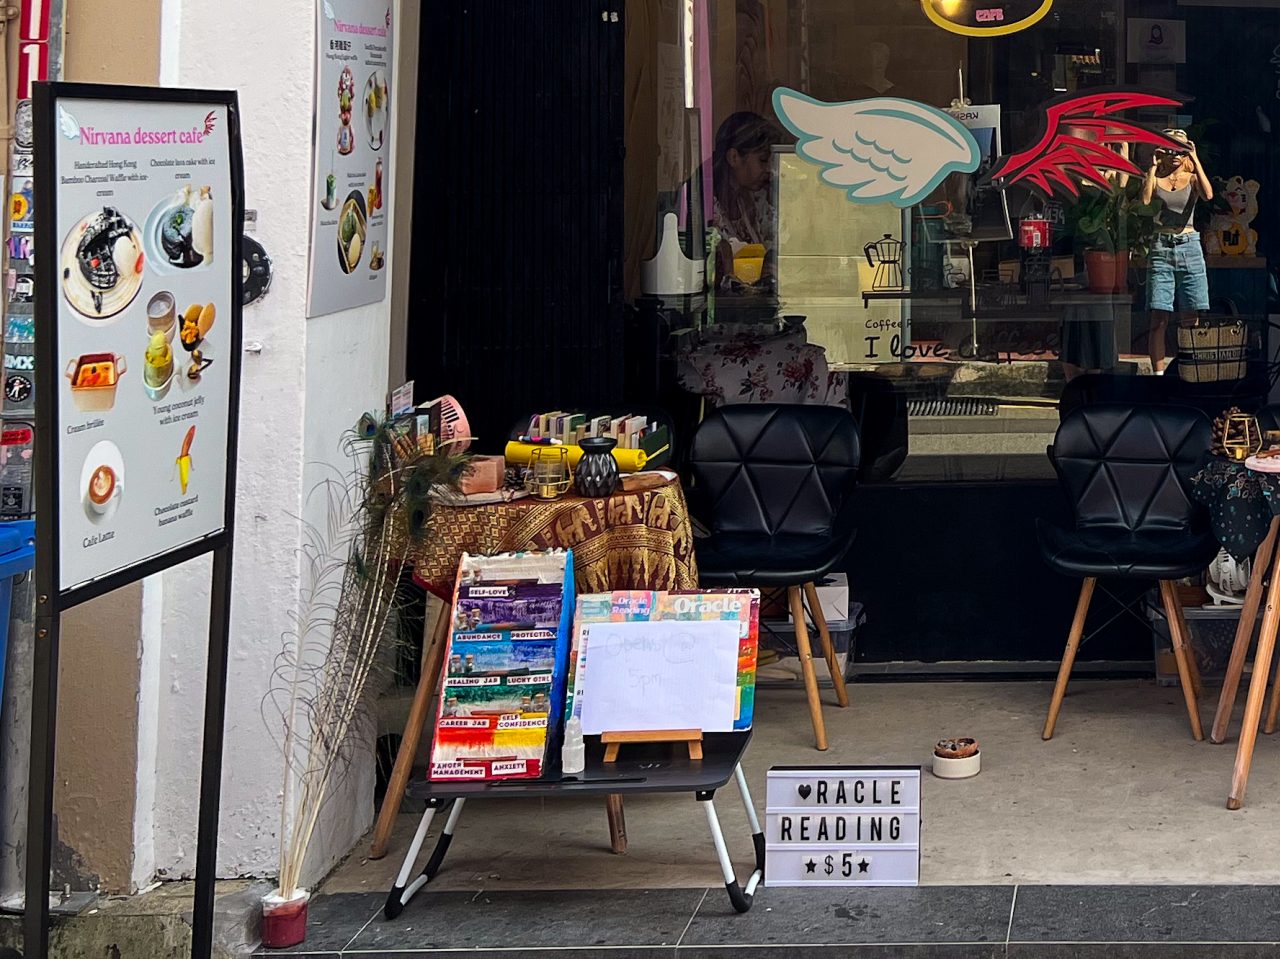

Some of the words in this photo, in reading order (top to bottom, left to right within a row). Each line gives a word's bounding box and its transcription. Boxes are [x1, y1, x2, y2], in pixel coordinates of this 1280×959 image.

[80, 127, 131, 145] Nirvana
[133, 127, 177, 144] dessert
[179, 126, 203, 143] cafe
[150, 159, 174, 167] Chocolate
[864, 337, 880, 357] I
[890, 335, 951, 357] love
[152, 402, 172, 415] Young
[171, 399, 193, 411] coconut
[193, 395, 205, 408] jelly
[159, 416, 172, 426] with
[181, 411, 199, 422] cream
[154, 503, 179, 517] Chocolate
[158, 514, 178, 527] banana
[177, 509, 194, 522] waffle
[82, 536, 98, 548] Cafe
[617, 596, 647, 605] Oracle
[673, 596, 743, 614] Oracle
[612, 605, 650, 617] Reading
[628, 668, 664, 693] 5pm
[499, 720, 546, 728] CONFIDENCE
[494, 763, 525, 771] ANXIETY
[781, 816, 900, 841] READING
